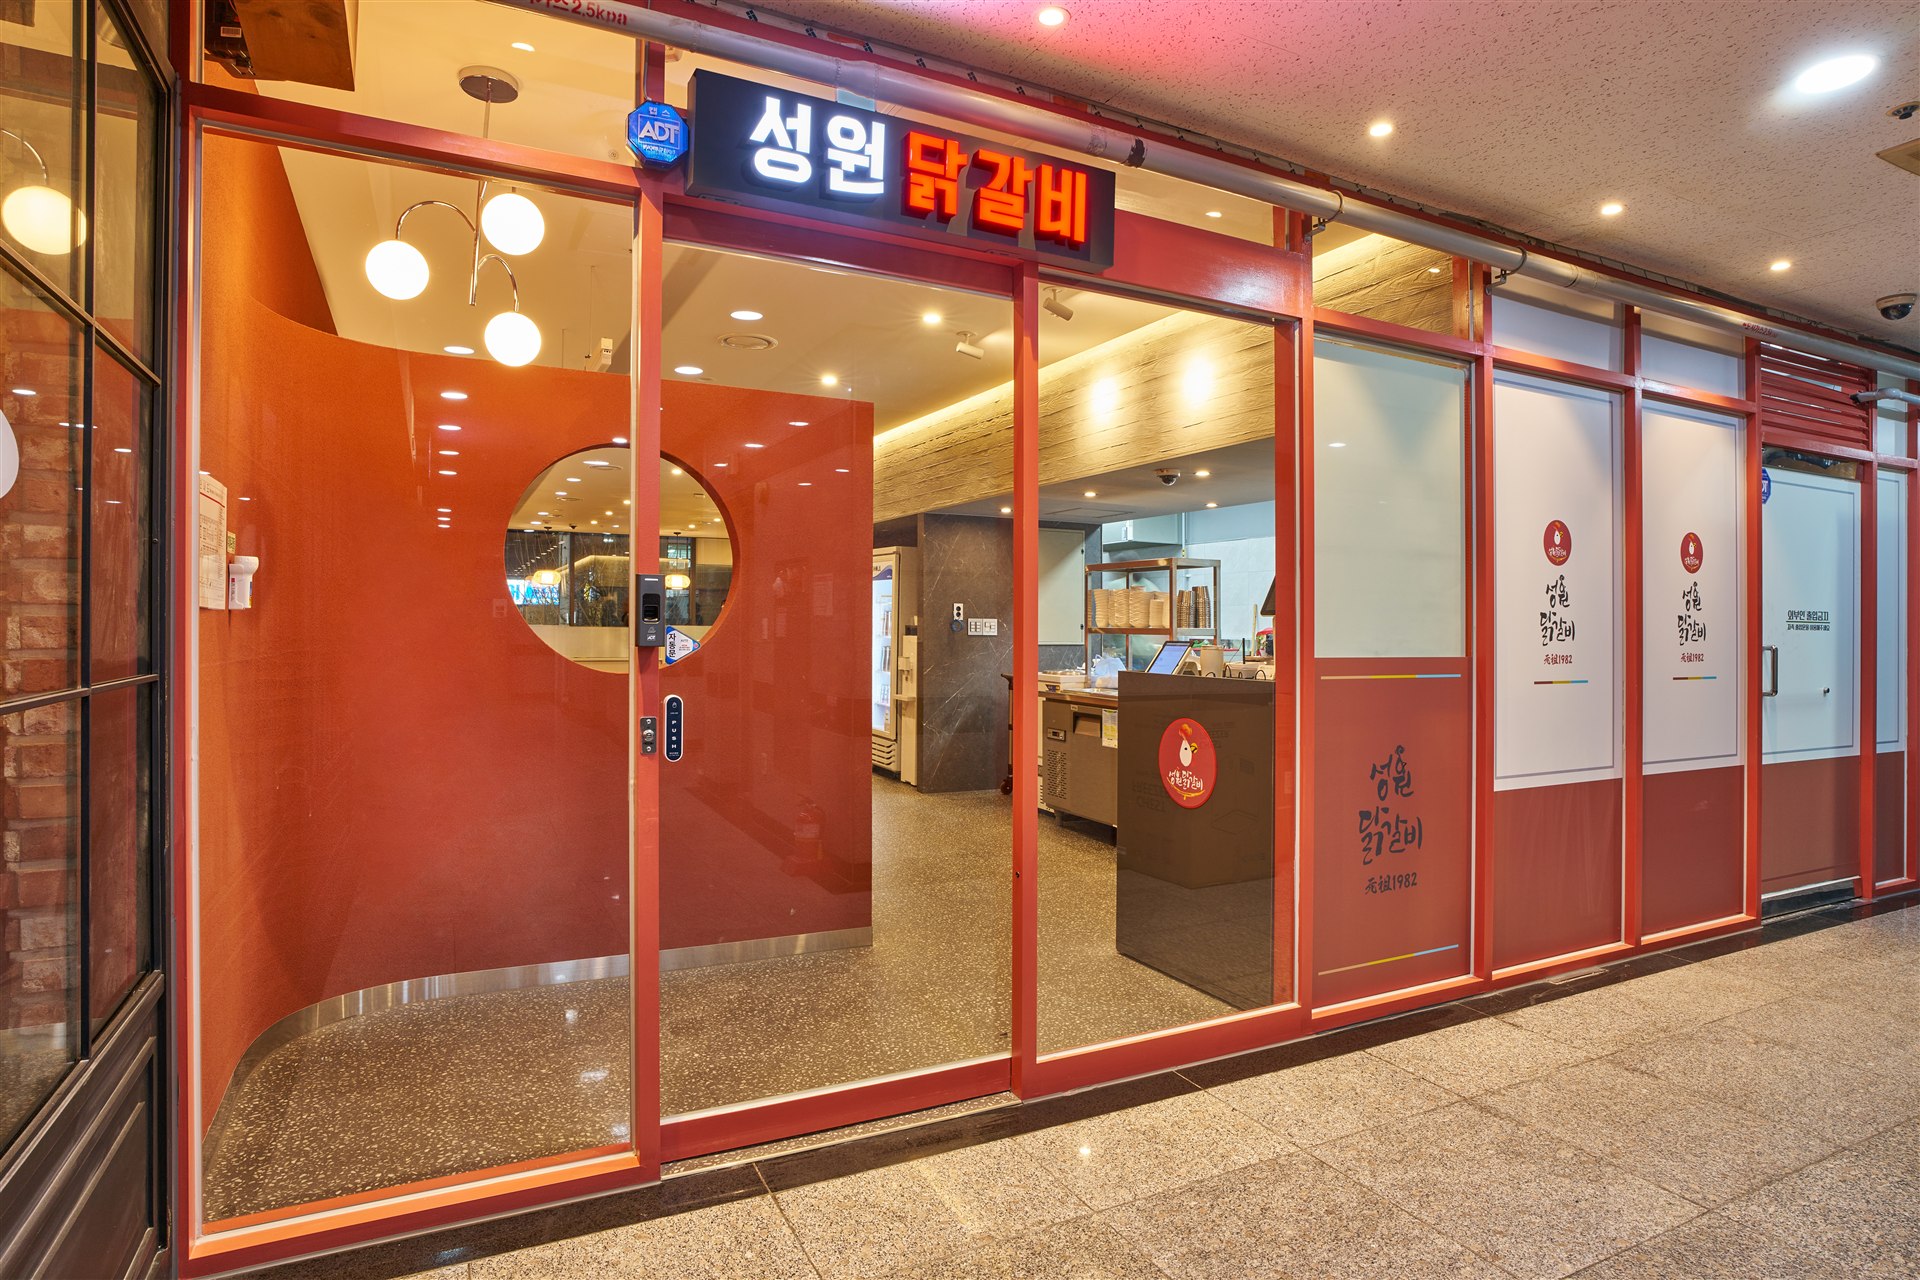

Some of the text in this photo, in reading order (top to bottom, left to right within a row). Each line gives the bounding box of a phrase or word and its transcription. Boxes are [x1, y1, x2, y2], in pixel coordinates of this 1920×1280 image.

[639, 121, 680, 144] ADT
[1546, 574, 1570, 608] 성원
[1682, 581, 1702, 612] 성원
[1540, 611, 1576, 646] 닭갈비
[1678, 614, 1706, 646] 닭갈비
[1788, 610, 1828, 621] 외부인 출입금지
[1370, 745, 1414, 801] 성원
[1359, 806, 1423, 866] 닭갈비
